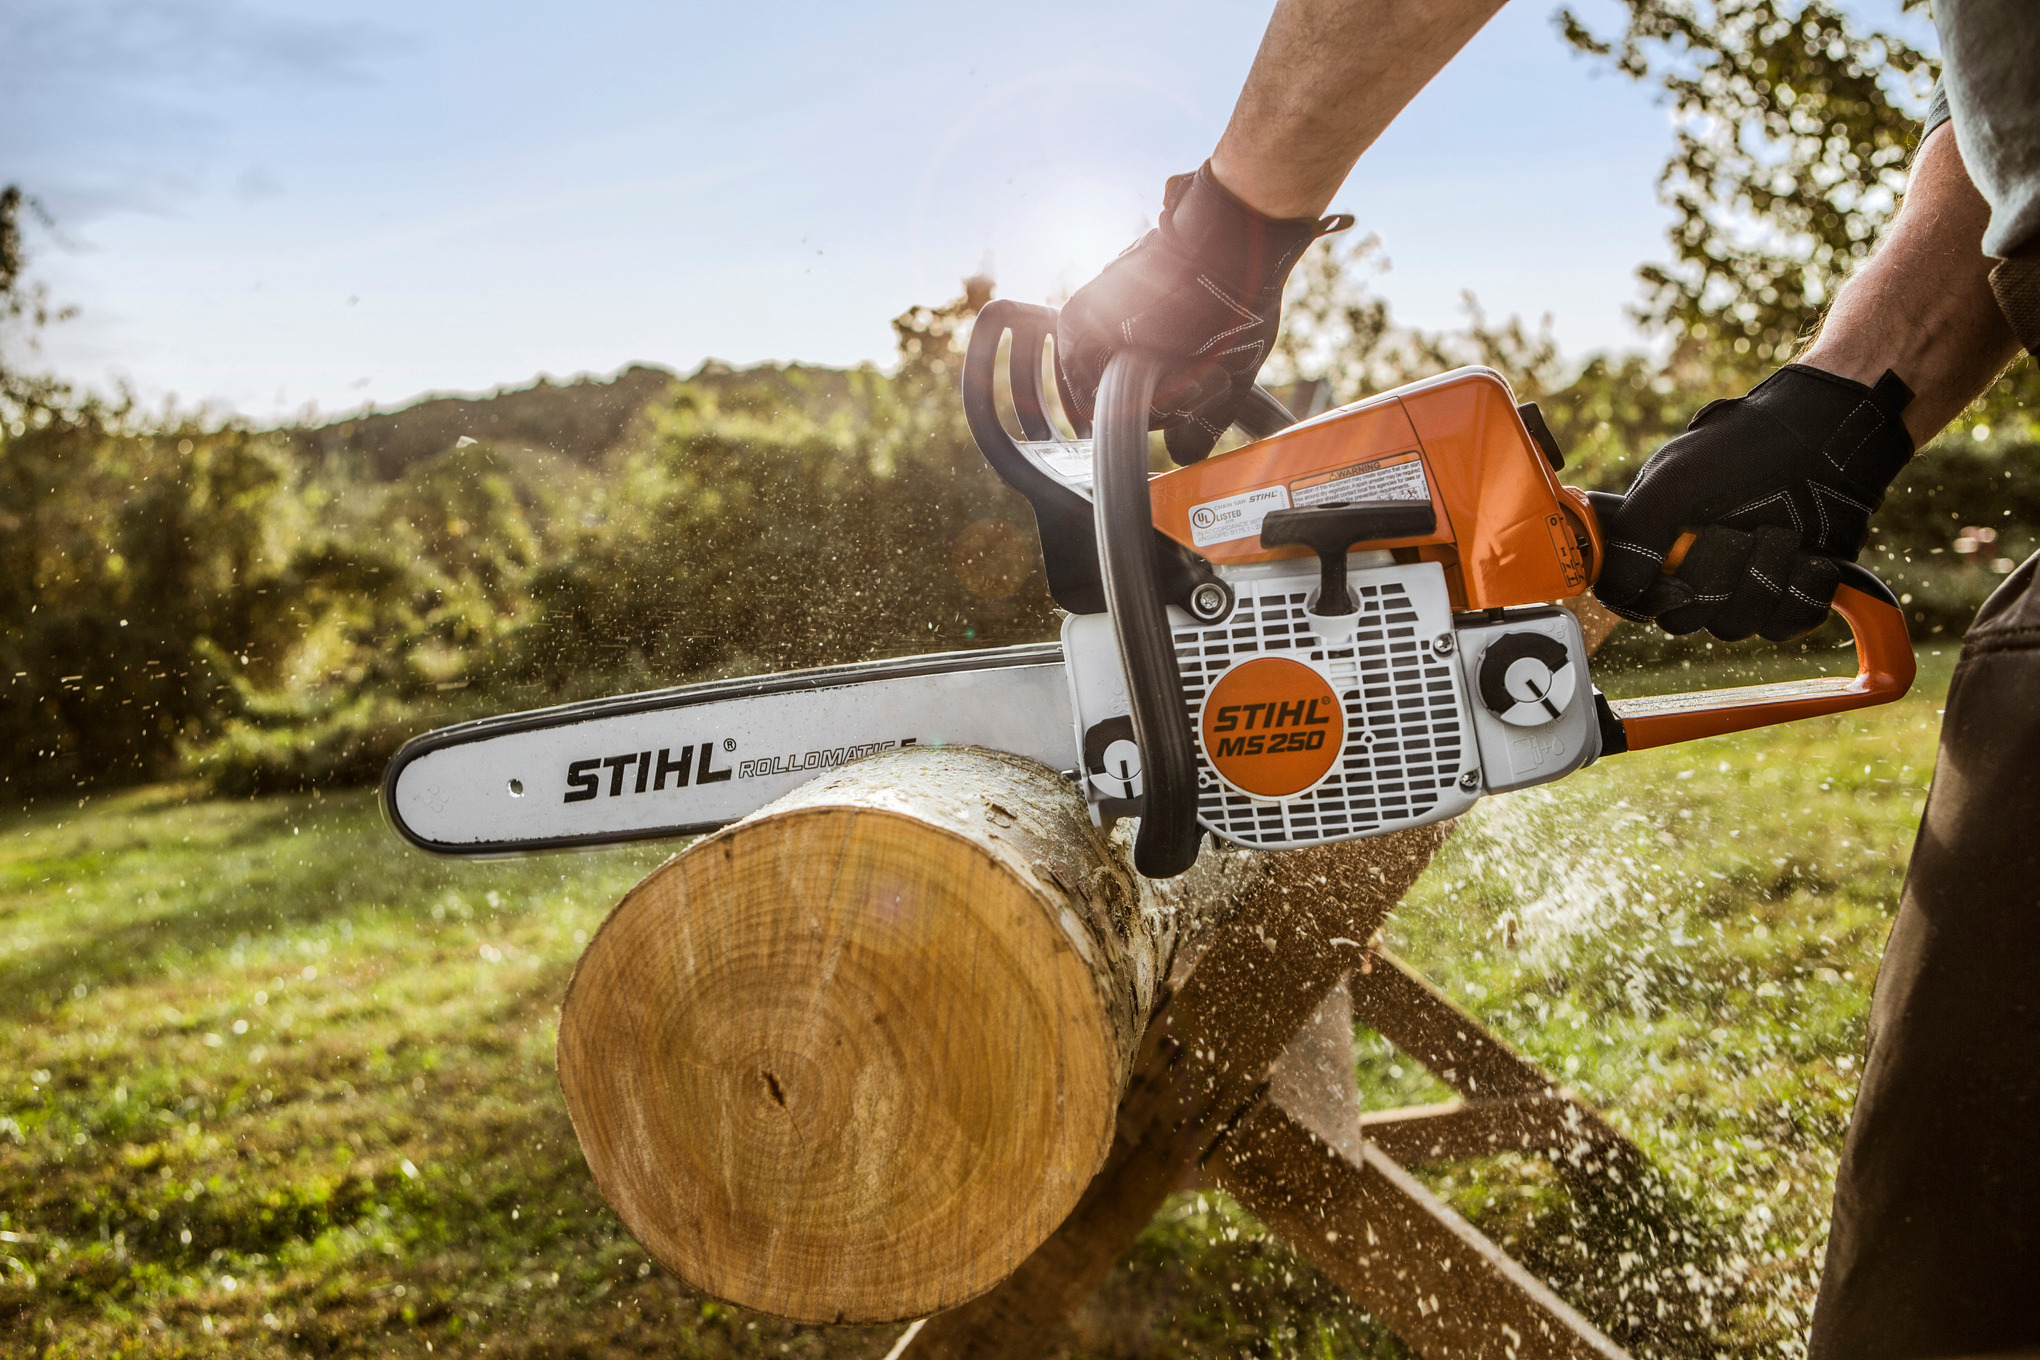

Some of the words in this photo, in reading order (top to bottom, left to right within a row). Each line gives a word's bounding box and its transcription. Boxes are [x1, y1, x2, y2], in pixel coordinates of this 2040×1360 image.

[1336, 462, 1380, 478] WARNING
[1292, 488, 1313, 496] Operation
[1327, 479, 1351, 488] equipment
[1340, 489, 1356, 497] contact
[1376, 480, 1397, 489] agencies
[1213, 502, 1232, 510] CHAIN
[1232, 498, 1247, 506] SAW
[1197, 512, 1211, 524] UL
[1215, 509, 1241, 521] LISTED
[1204, 520, 1248, 536] ACCORDANCE
[1249, 516, 1262, 525] WIT
[1216, 734, 1266, 757] MS
[1266, 730, 1325, 754] 250
